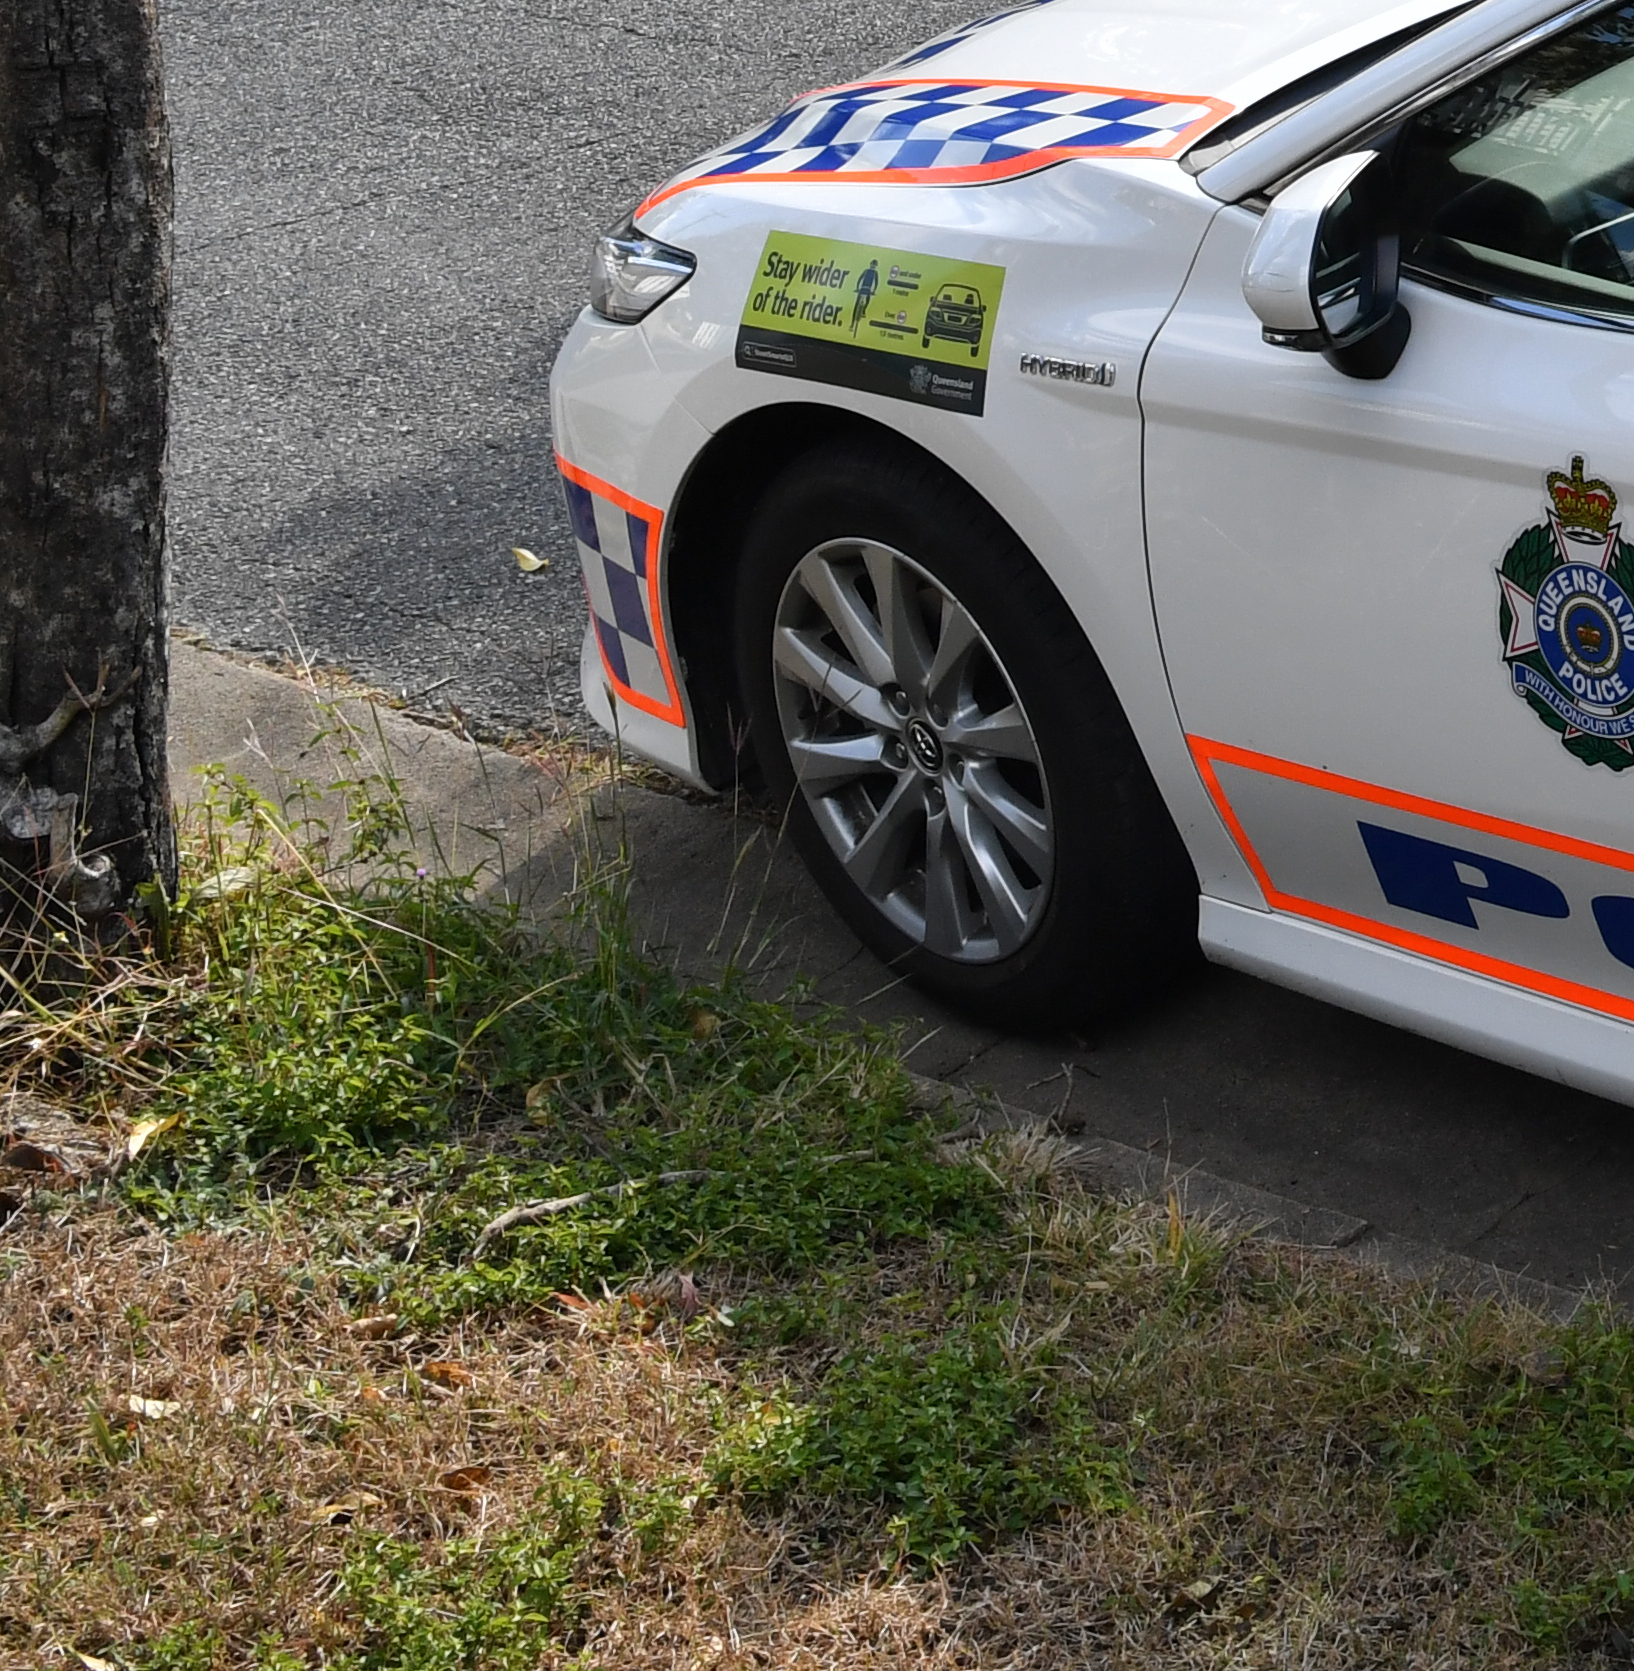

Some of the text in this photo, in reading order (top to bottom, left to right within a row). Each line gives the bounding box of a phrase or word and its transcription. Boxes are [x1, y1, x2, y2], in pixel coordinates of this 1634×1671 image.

[762, 251, 802, 287] Stay
[801, 258, 851, 289] wider
[752, 286, 843, 327] of the rider.
[932, 374, 974, 391] Queensland
[1020, 352, 1100, 384] HYBRID
[931, 385, 973, 401] Government
[1558, 661, 1629, 702] POLICE
[1524, 669, 1555, 700] WITH
[1554, 696, 1608, 734] HONOUR
[1609, 718, 1629, 735] WE
